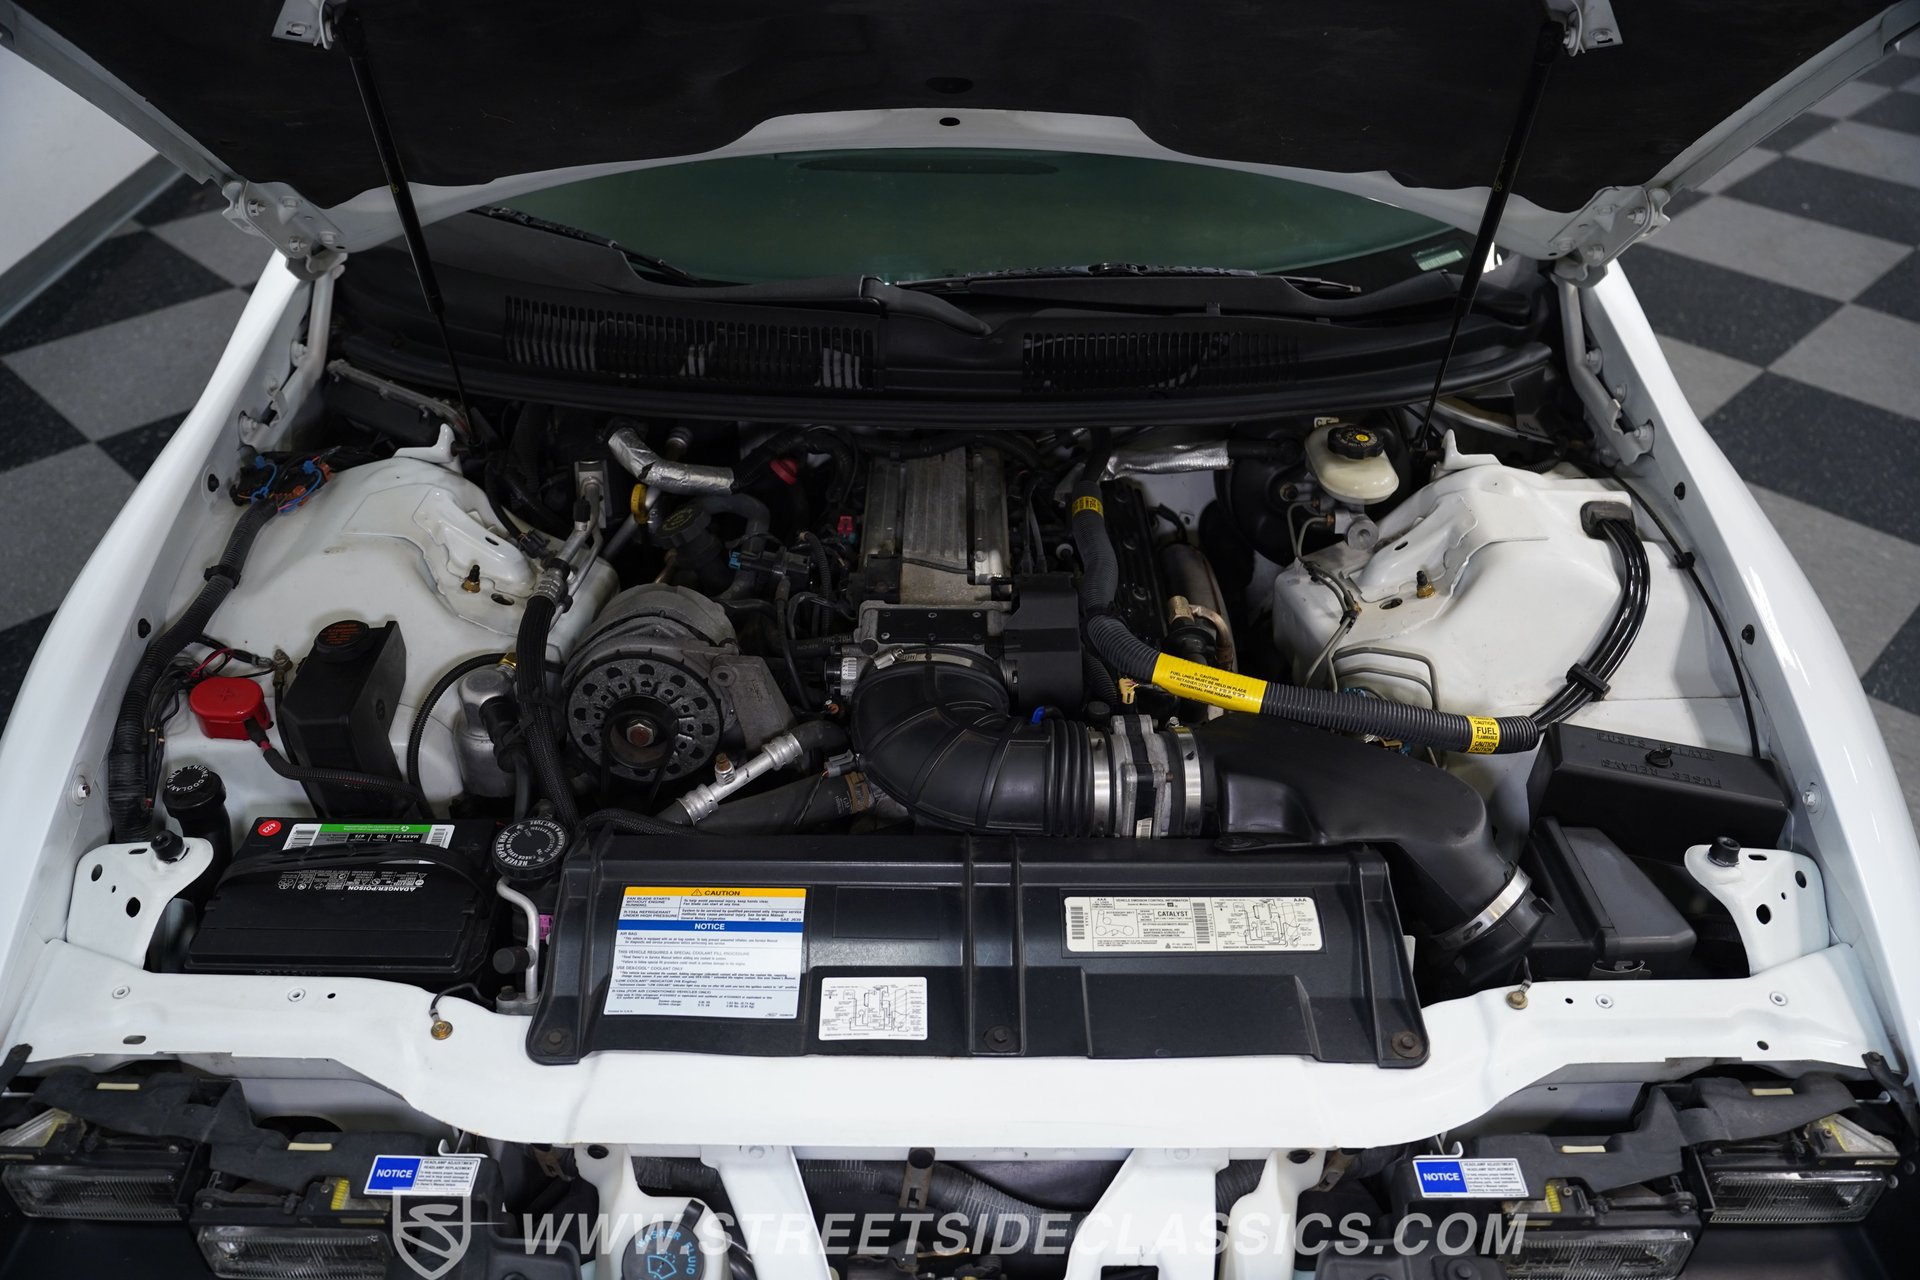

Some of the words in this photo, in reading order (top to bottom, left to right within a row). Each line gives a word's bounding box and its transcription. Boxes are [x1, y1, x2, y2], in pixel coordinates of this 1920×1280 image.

[1476, 727, 1497, 735] FUEL
[1597, 731, 1647, 748] FUSES
[166, 779, 205, 792] COOLANT
[498, 831, 510, 843] HOT
[497, 843, 507, 858] OPEN
[504, 857, 528, 866] NEVER
[375, 1168, 413, 1178] NOTICE
[1423, 1172, 1460, 1181] NOTICE
[636, 1228, 682, 1248] WASHER
[684, 1241, 697, 1275] FLUID
